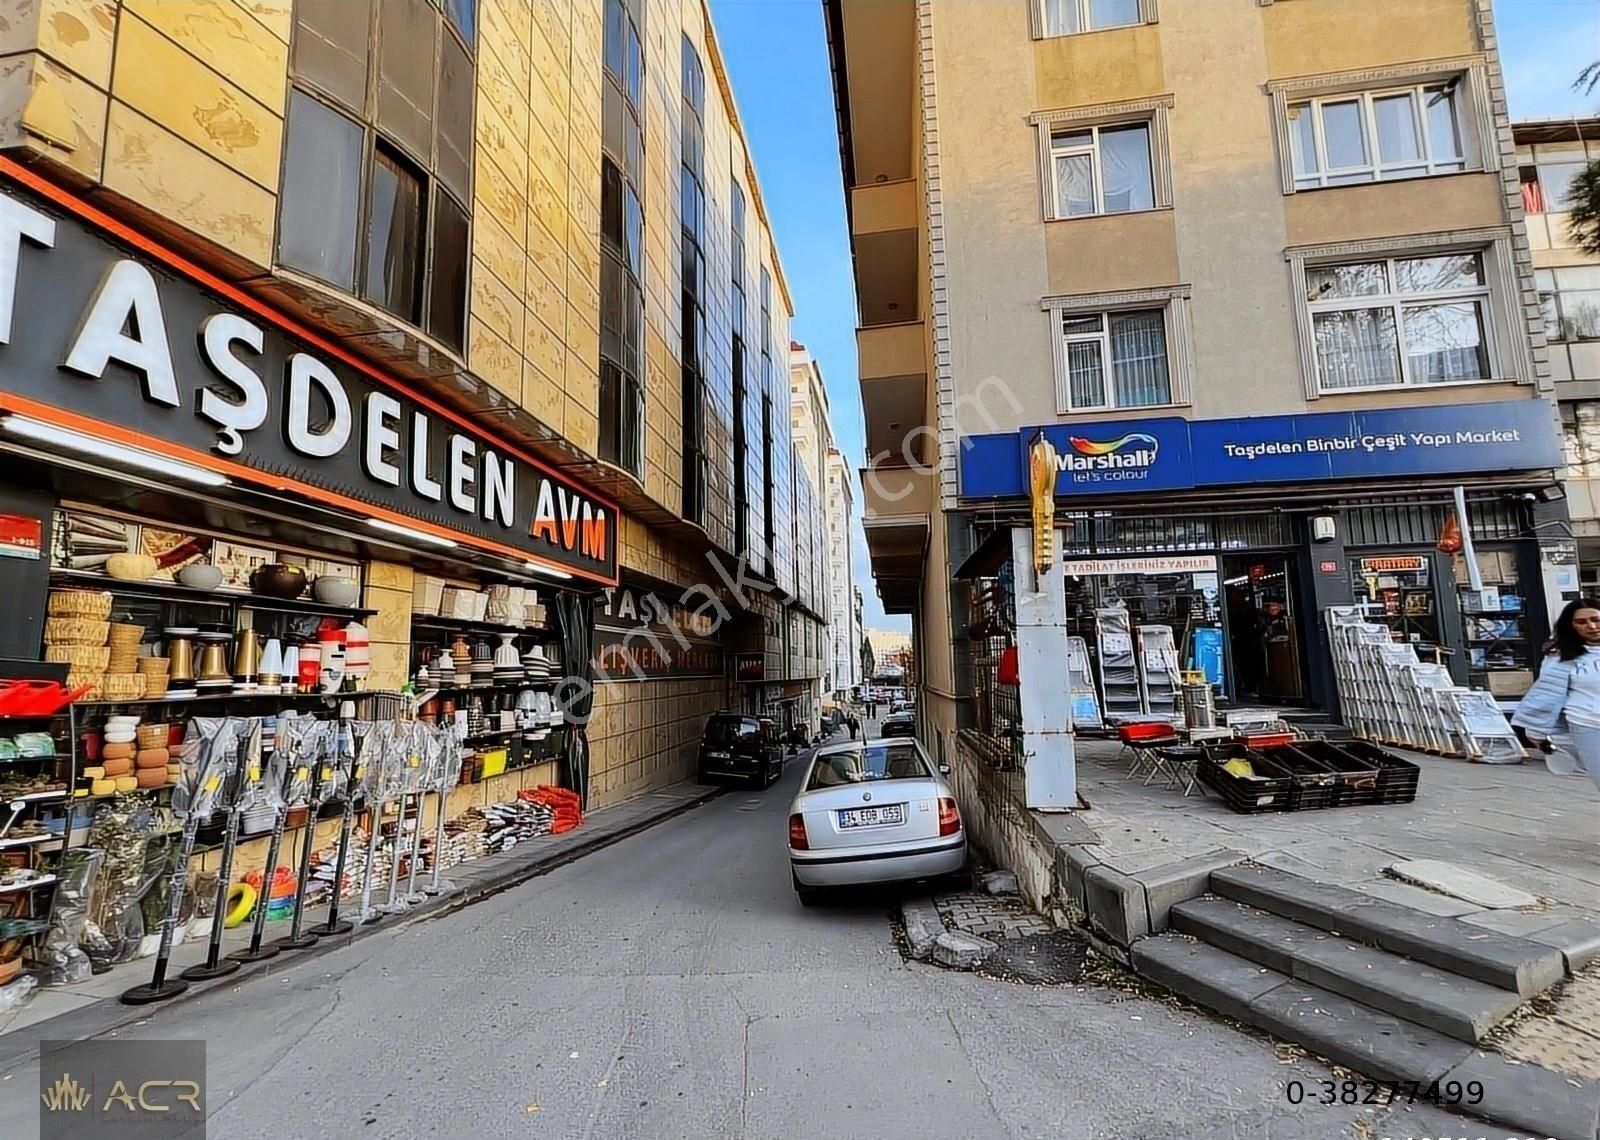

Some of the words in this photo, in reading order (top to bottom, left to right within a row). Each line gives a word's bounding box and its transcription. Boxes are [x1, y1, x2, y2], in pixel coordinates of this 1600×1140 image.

[0, 192, 514, 527] TAŞDELEN
[530, 479, 605, 560] AVM
[1224, 442, 1302, 459] Taşdelen
[1306, 438, 1357, 452] Binbir
[1362, 434, 1406, 452] Çeşit
[1410, 433, 1451, 447] Yapı
[1456, 429, 1520, 443] Market
[1056, 450, 1149, 471] Marshall
[1073, 471, 1100, 482] let's
[1104, 470, 1147, 481] colour
